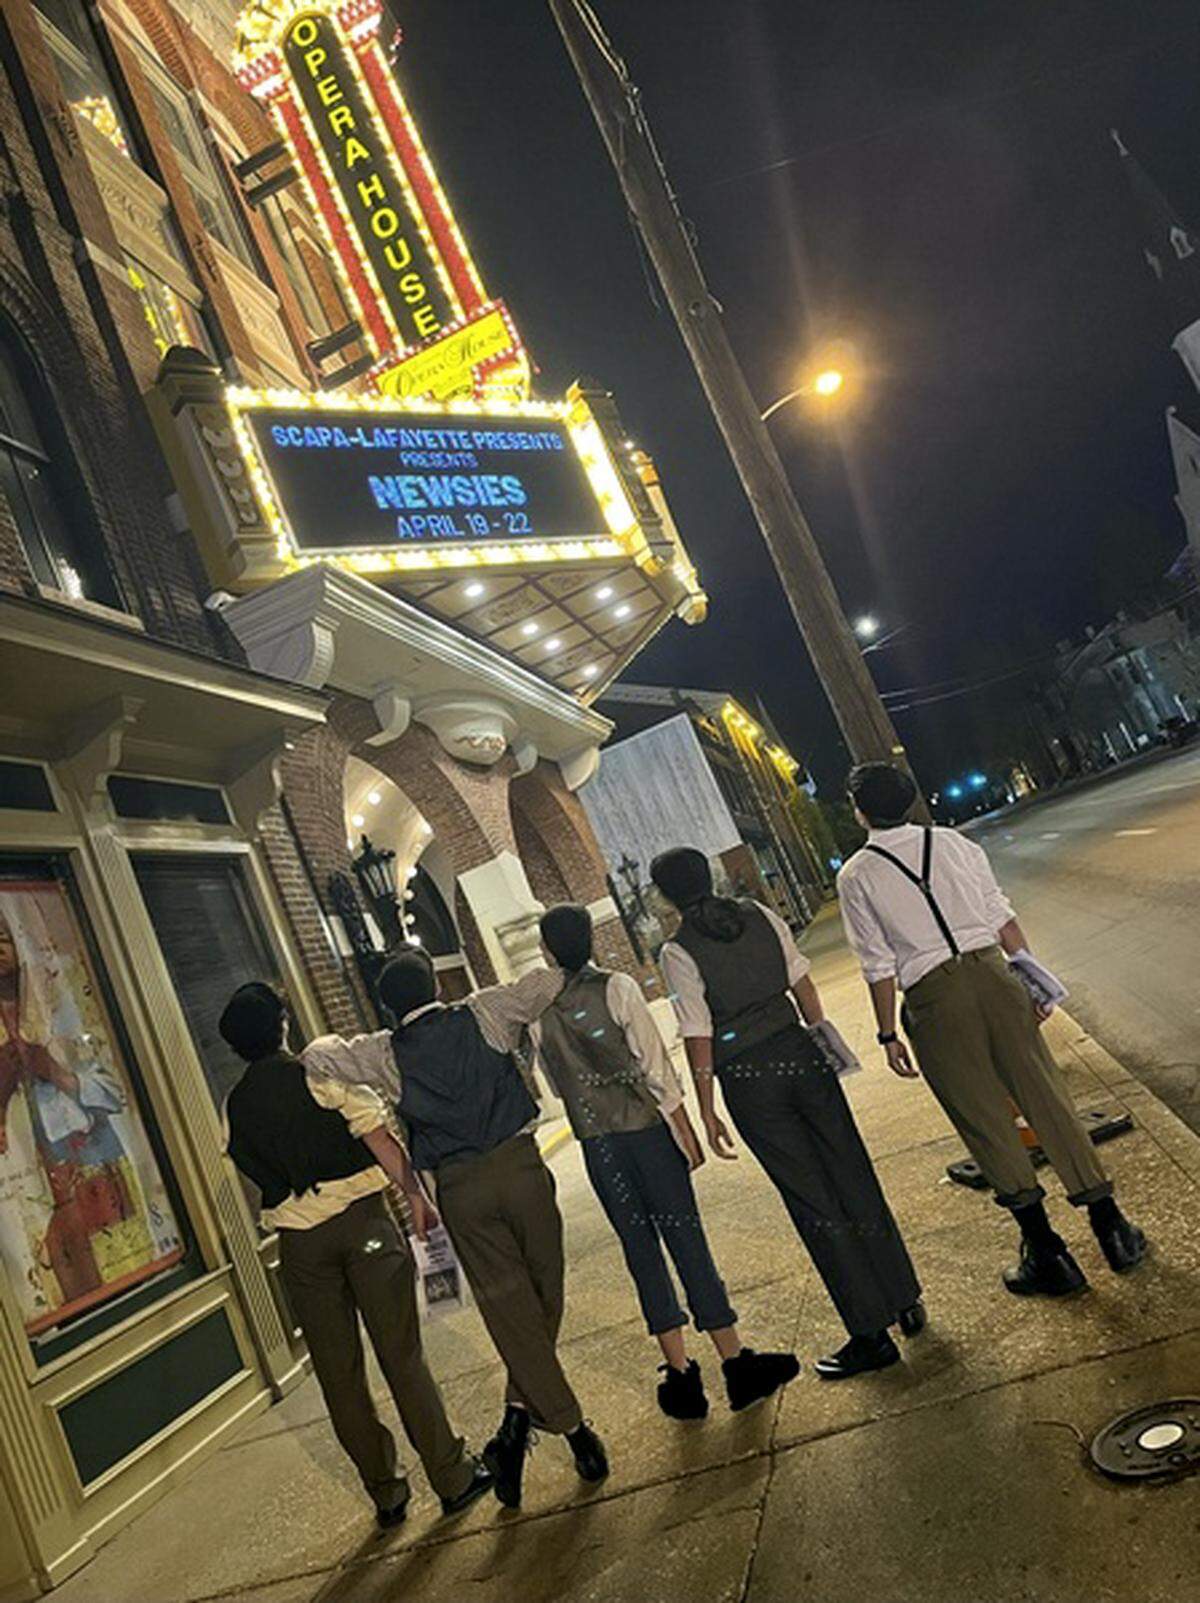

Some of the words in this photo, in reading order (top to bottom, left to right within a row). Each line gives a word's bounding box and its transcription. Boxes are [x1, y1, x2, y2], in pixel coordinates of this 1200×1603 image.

[292, 18, 370, 169] OPERA
[357, 173, 441, 338] HOUSE
[271, 425, 473, 449] SCAPA-LAFAYETTE
[472, 430, 564, 450] PRESENTS
[399, 451, 479, 469] PRESENTS
[368, 475, 529, 509] NEWSIES
[397, 514, 465, 539] APRIL
[465, 512, 491, 536] 19
[503, 511, 534, 534] 22
